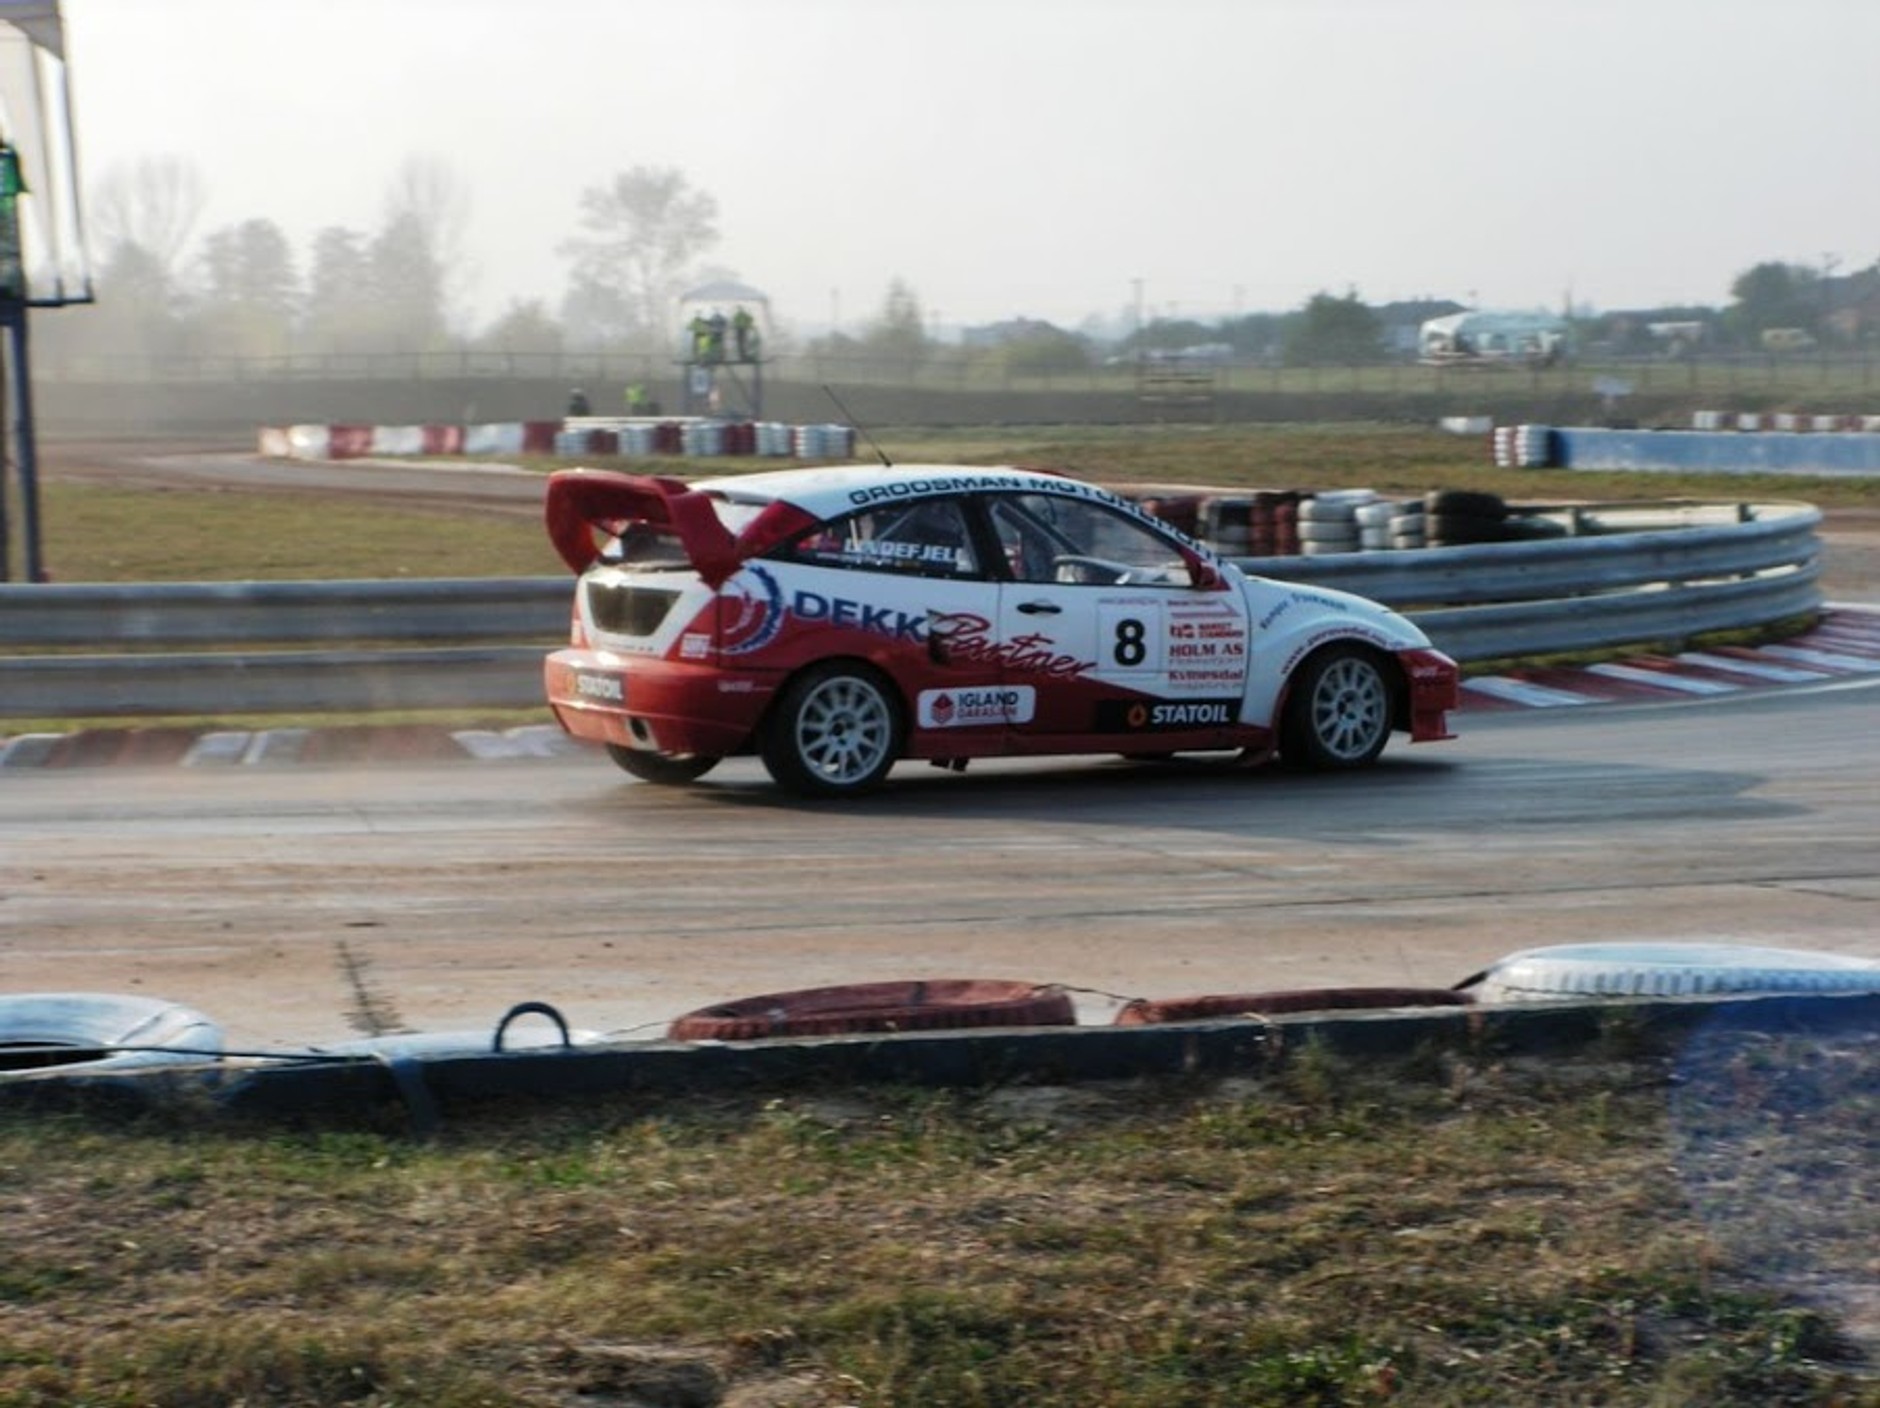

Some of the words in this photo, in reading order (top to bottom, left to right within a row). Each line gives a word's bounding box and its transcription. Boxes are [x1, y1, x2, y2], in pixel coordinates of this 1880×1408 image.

[1114, 619, 1146, 667] 8
[1169, 644, 1216, 657] HOLM
[1222, 643, 1243, 655] AS
[577, 675, 623, 699] STATOIL
[957, 691, 1018, 707] IGLAND
[1152, 704, 1229, 724] STATOIL
